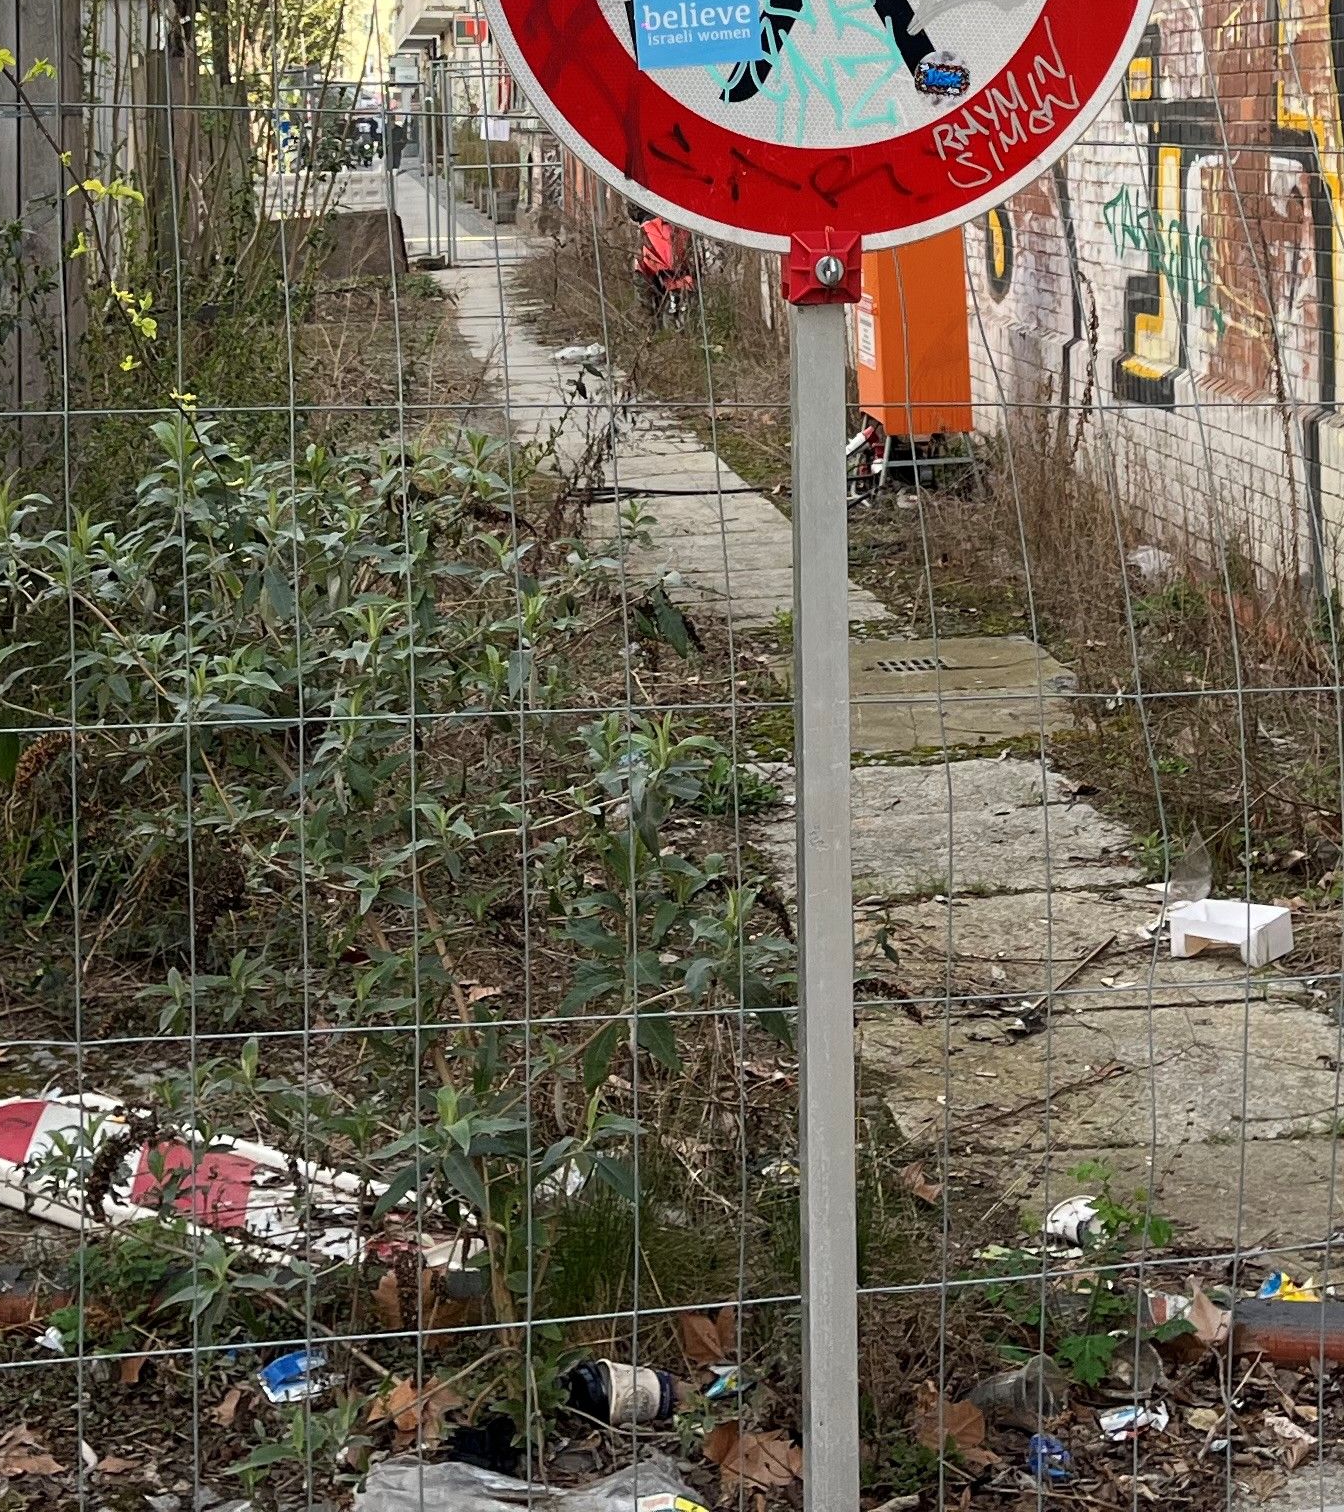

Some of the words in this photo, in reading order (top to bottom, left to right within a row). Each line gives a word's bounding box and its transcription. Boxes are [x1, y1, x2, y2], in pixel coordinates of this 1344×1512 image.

[642, 1, 751, 31] believe
[647, 29, 693, 47] israeli
[697, 28, 752, 42] women
